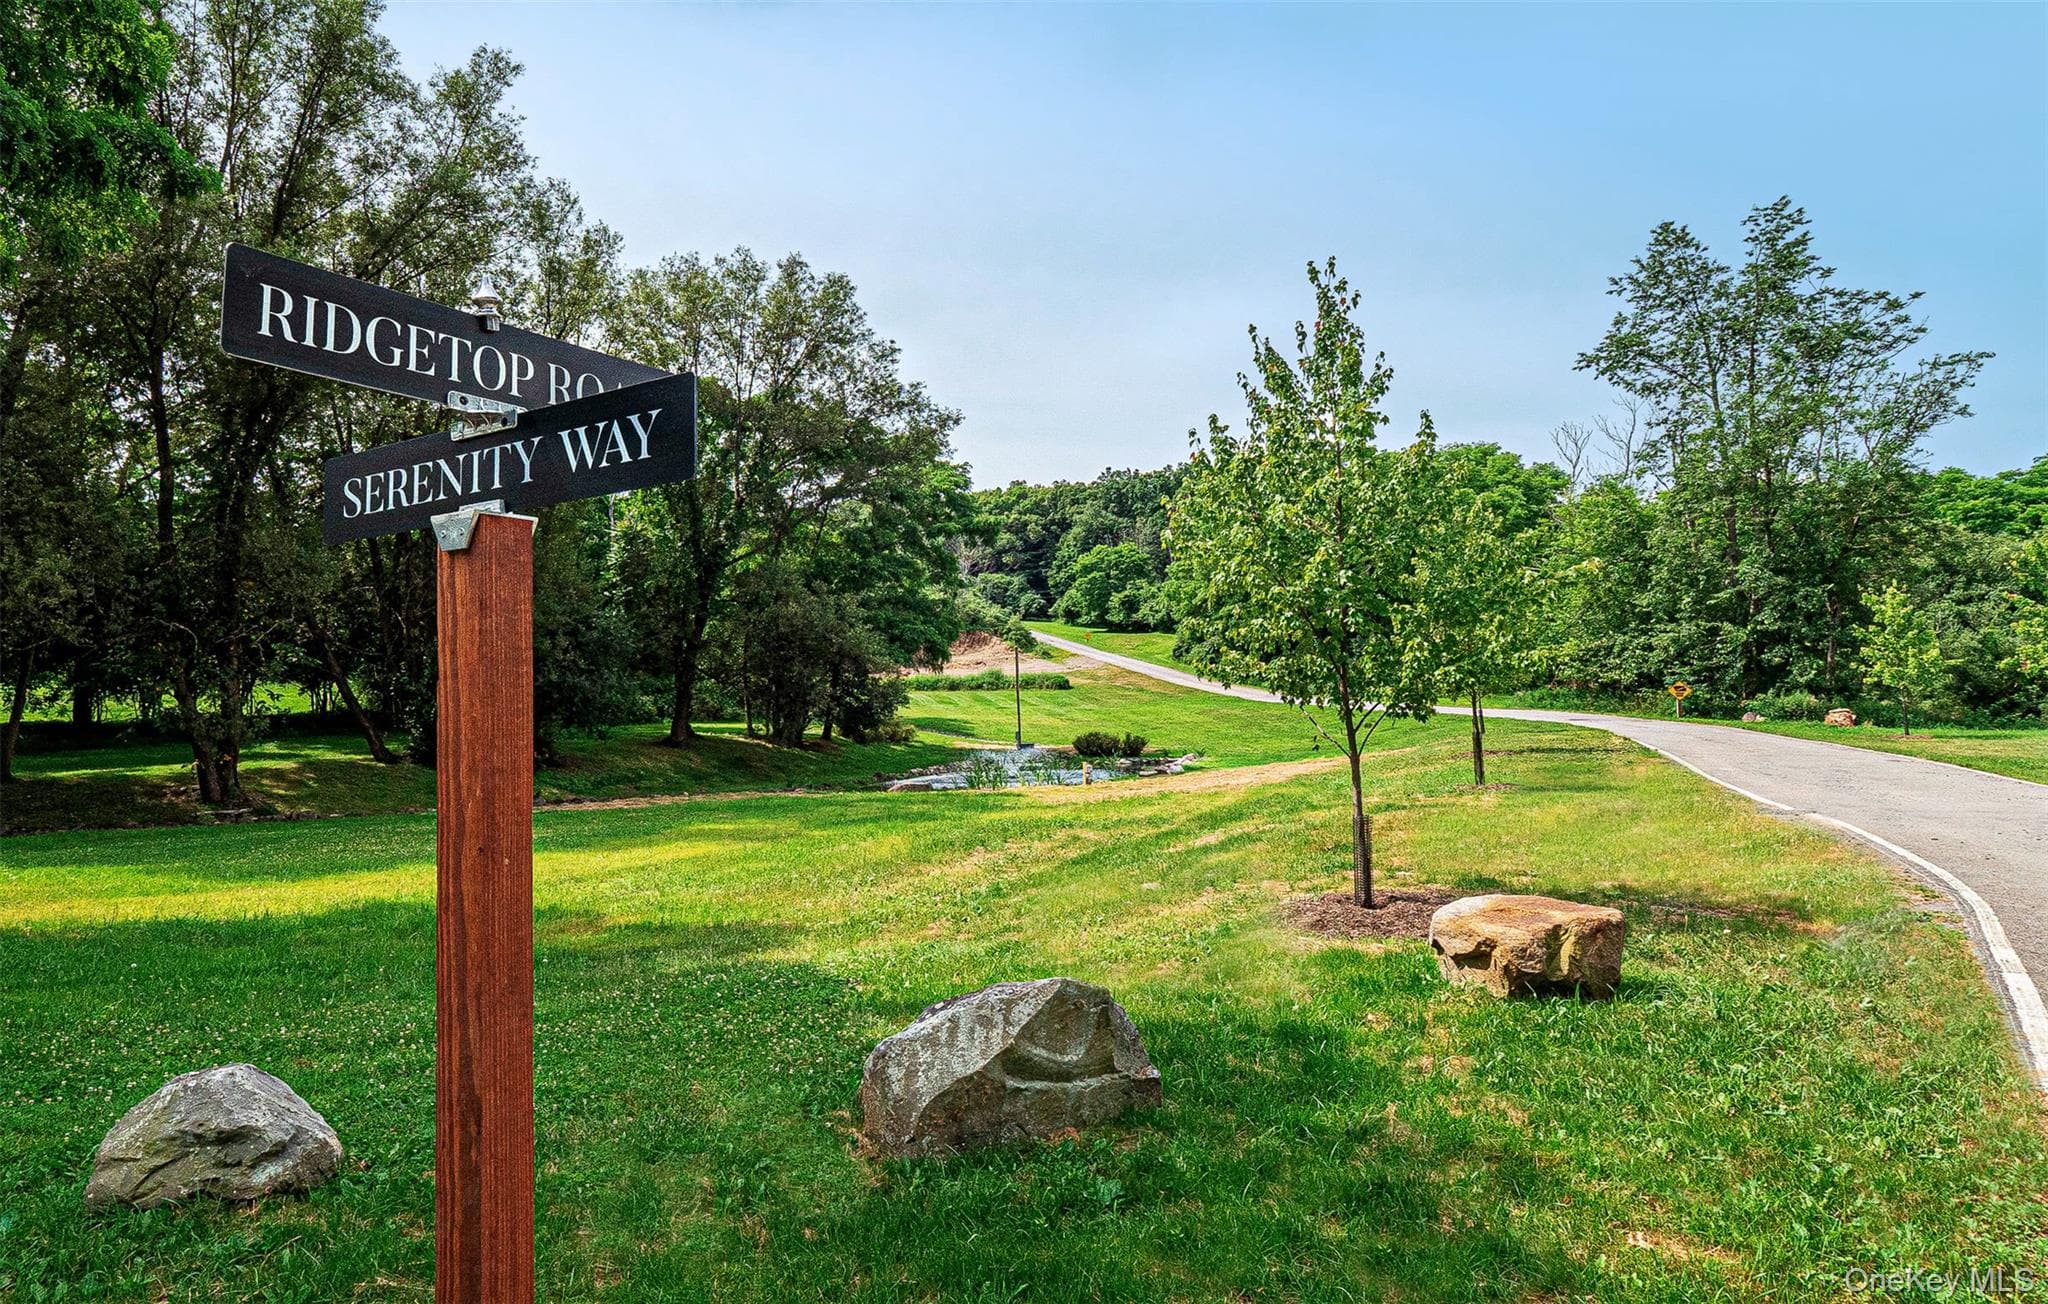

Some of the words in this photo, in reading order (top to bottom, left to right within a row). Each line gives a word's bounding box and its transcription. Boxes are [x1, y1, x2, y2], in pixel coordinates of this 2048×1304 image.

[257, 283, 535, 398] RIDGETOP
[547, 362, 622, 405] RO
[343, 437, 543, 519] SERENITY
[558, 408, 663, 473] WAY
